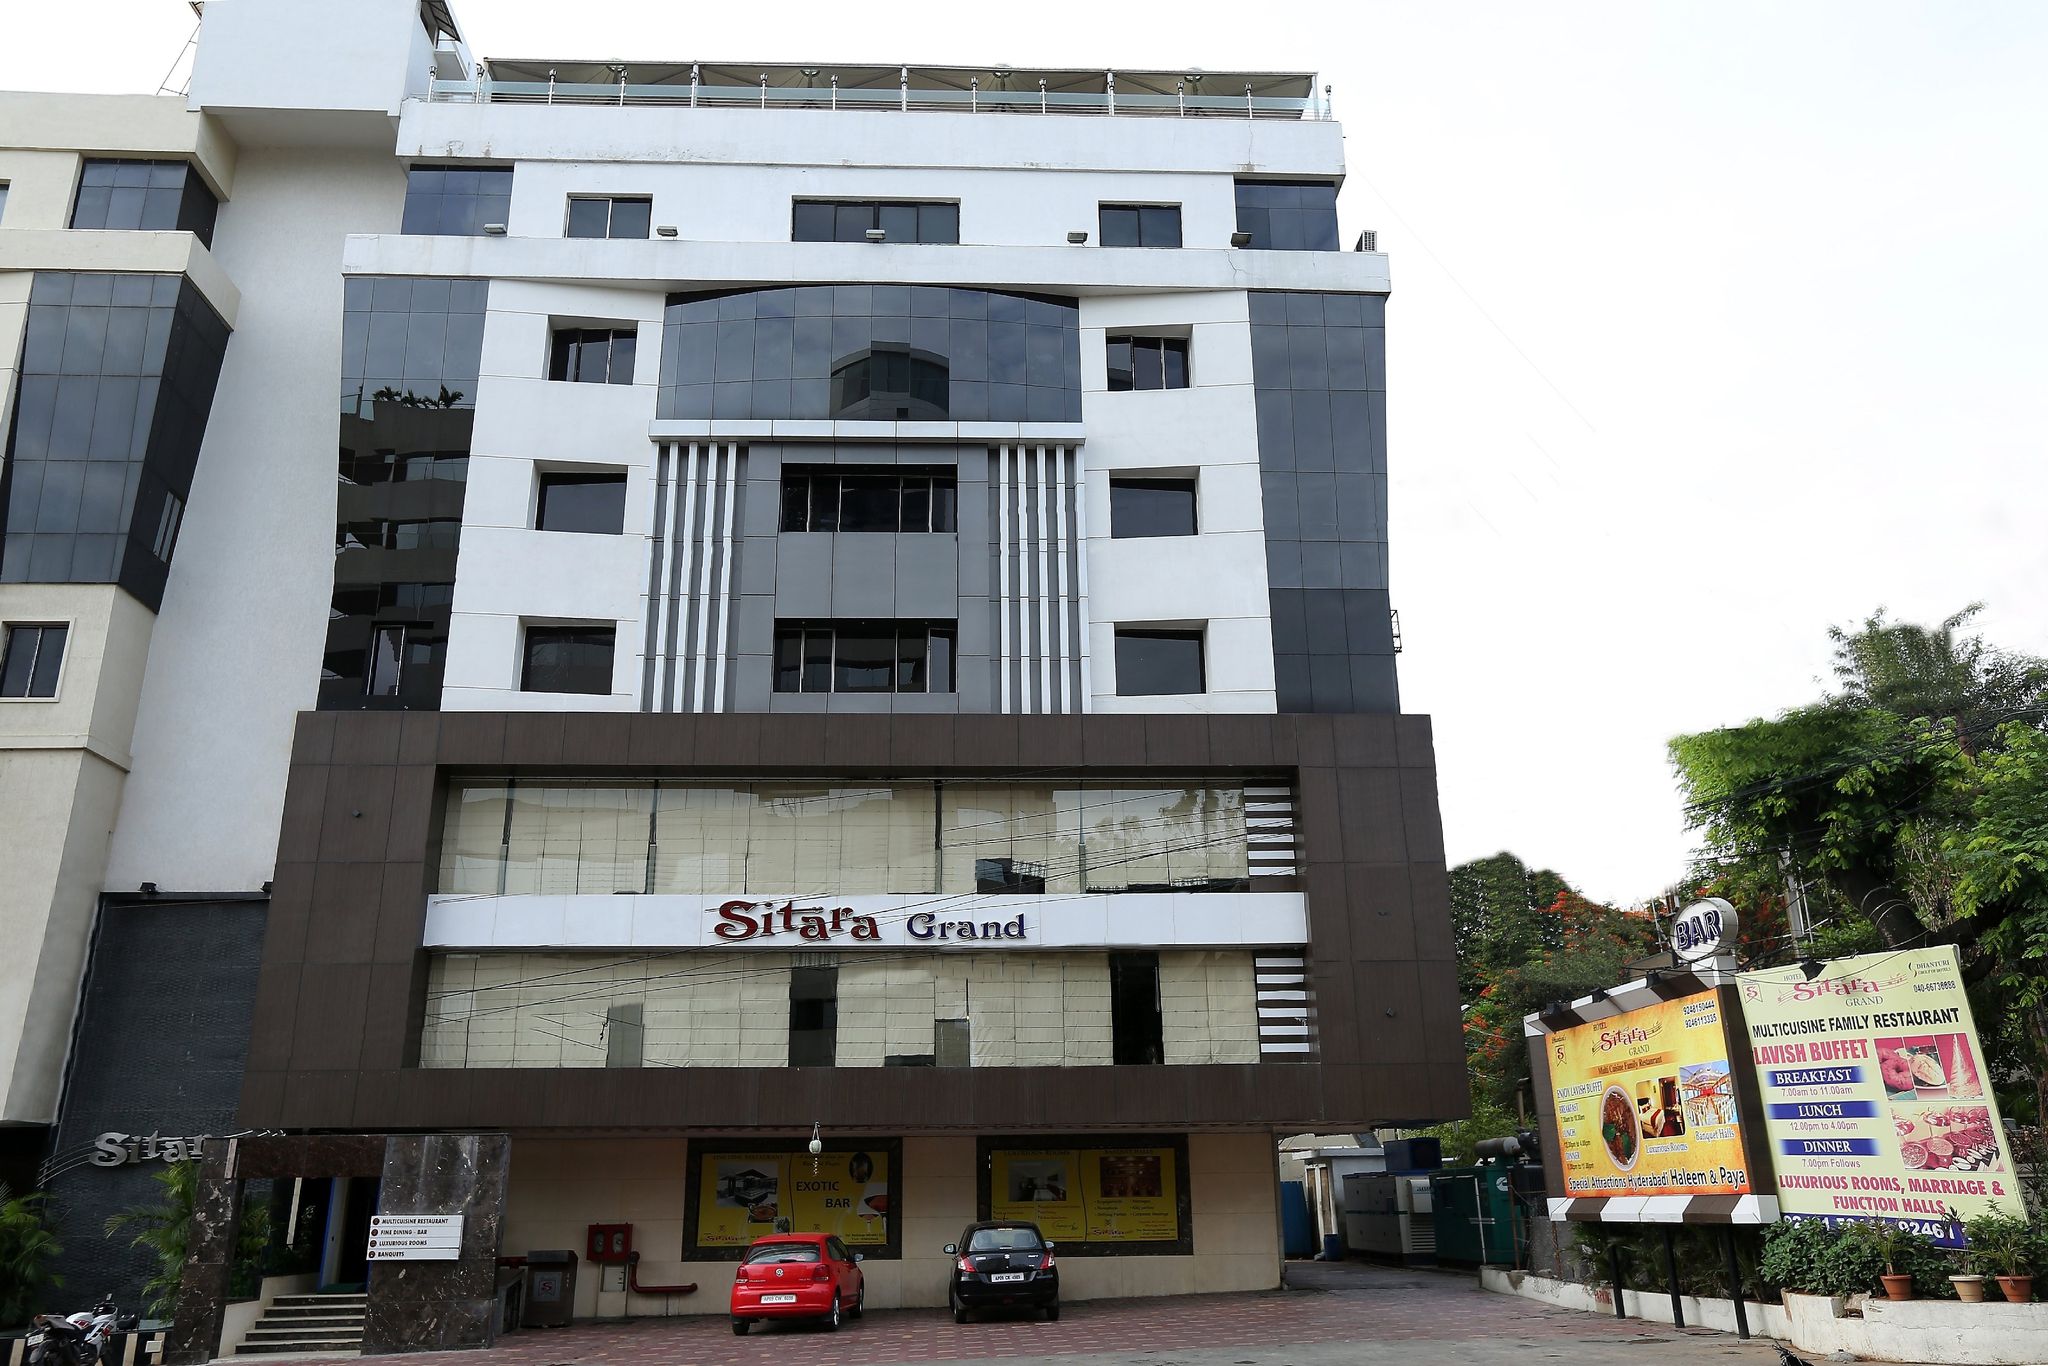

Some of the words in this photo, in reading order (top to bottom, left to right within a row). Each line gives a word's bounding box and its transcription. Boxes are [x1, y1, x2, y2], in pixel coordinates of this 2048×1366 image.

[714, 900, 882, 940] Sitara
[906, 912, 1027, 939] Grand
[1675, 910, 1721, 951] BAR
[1916, 960, 1950, 970] DHANTURI
[1793, 978, 1879, 1002] Sitara
[1845, 996, 1883, 1008] GRAND
[1752, 1019, 1827, 1039] MULTICUISINE
[1829, 1015, 1869, 1032] FAMILY
[1874, 1008, 1960, 1029] RESTAURANT
[1600, 1028, 1647, 1051] Sitara
[1629, 1044, 1650, 1056] GRAND
[1753, 1043, 1807, 1065] LAVISH
[1809, 1039, 1869, 1061] BUFFET
[1638, 1056, 1662, 1067] Restaurant
[1776, 1069, 1852, 1085] BREAKFAST
[1586, 1081, 1603, 1094] BUFFET
[1781, 1087, 1809, 1097] 7.00am
[1810, 1087, 1818, 1096] to
[1820, 1086, 1853, 1095] 11.00am
[1798, 1104, 1843, 1117] LUNCH
[1790, 1122, 1820, 1132] 12.00pm
[1821, 1121, 1829, 1130] to
[1831, 1121, 1858, 1131] 4.00pm
[1696, 1131, 1718, 1142] Banquet
[1719, 1128, 1735, 1139] Halls
[1646, 1144, 1669, 1153] Luxurious
[1670, 1143, 1688, 1152] Rooms
[1803, 1140, 1852, 1153] DINNER
[1802, 1159, 1829, 1169] 7.00pm
[1831, 1158, 1861, 1168] Follows
[1569, 1177, 1589, 1191] Special
[1592, 1175, 1626, 1189] Attractions
[1628, 1173, 1668, 1191] Hyderabadi
[1670, 1168, 1707, 1186] Haleem
[1710, 1169, 1718, 1184] &
[1720, 1166, 1746, 1189] Paya
[796, 1181, 840, 1192] EXOTIC
[1779, 1175, 1848, 1190] LUXURIOUS
[1850, 1177, 1905, 1194] ROOMS,
[1908, 1179, 1987, 1196] MARRIAGE
[1992, 1180, 2005, 1196] &
[825, 1198, 850, 1208] BAR
[1833, 1196, 1898, 1213] FUNCTION
[1901, 1198, 1945, 1215] HALLS
